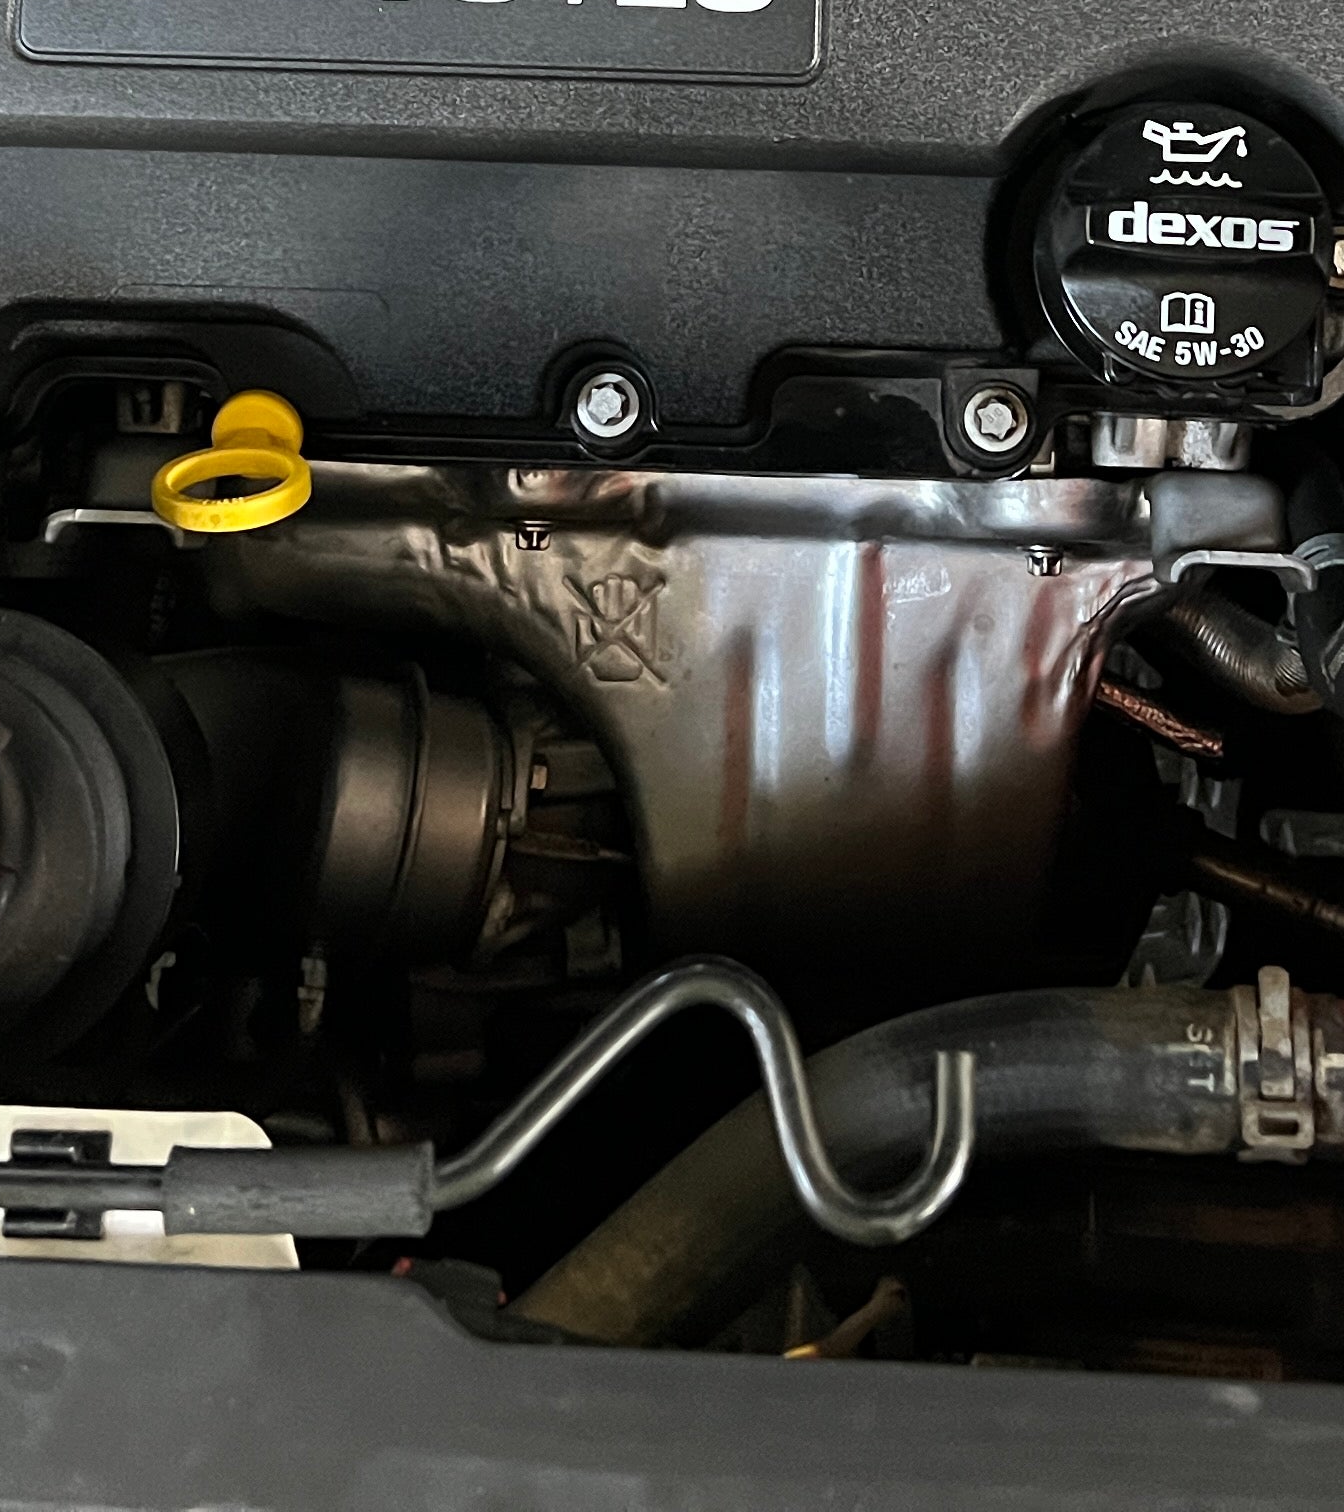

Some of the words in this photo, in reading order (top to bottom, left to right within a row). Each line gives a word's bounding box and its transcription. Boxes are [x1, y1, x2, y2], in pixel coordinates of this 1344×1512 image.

[1108, 201, 1296, 252] dexos
[1114, 320, 1166, 362] SAE
[1174, 326, 1265, 367] 5W-30
